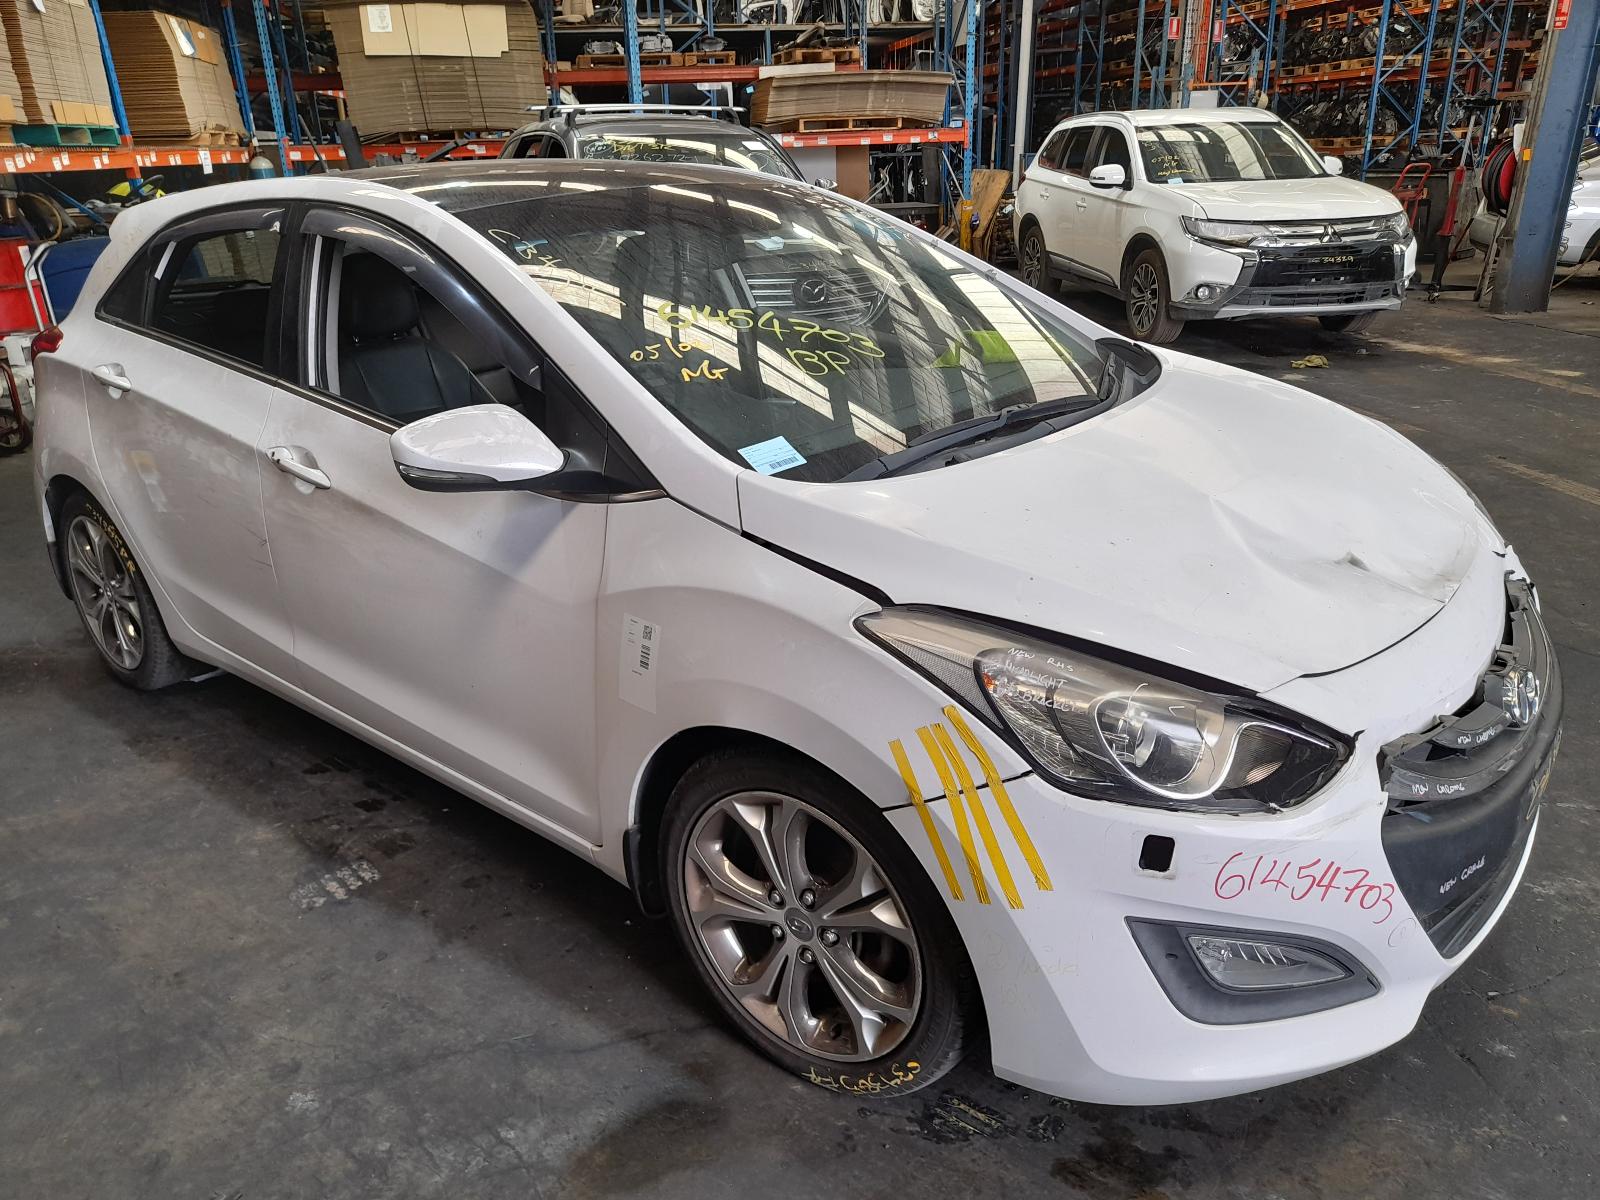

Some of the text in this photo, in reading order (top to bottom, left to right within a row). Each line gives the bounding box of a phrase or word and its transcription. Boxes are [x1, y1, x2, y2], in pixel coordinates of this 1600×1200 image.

[658, 301, 885, 358] 61454703
[786, 347, 850, 376] BP
[1008, 647, 1035, 659] NEW
[1214, 851, 1396, 924] 61454703
